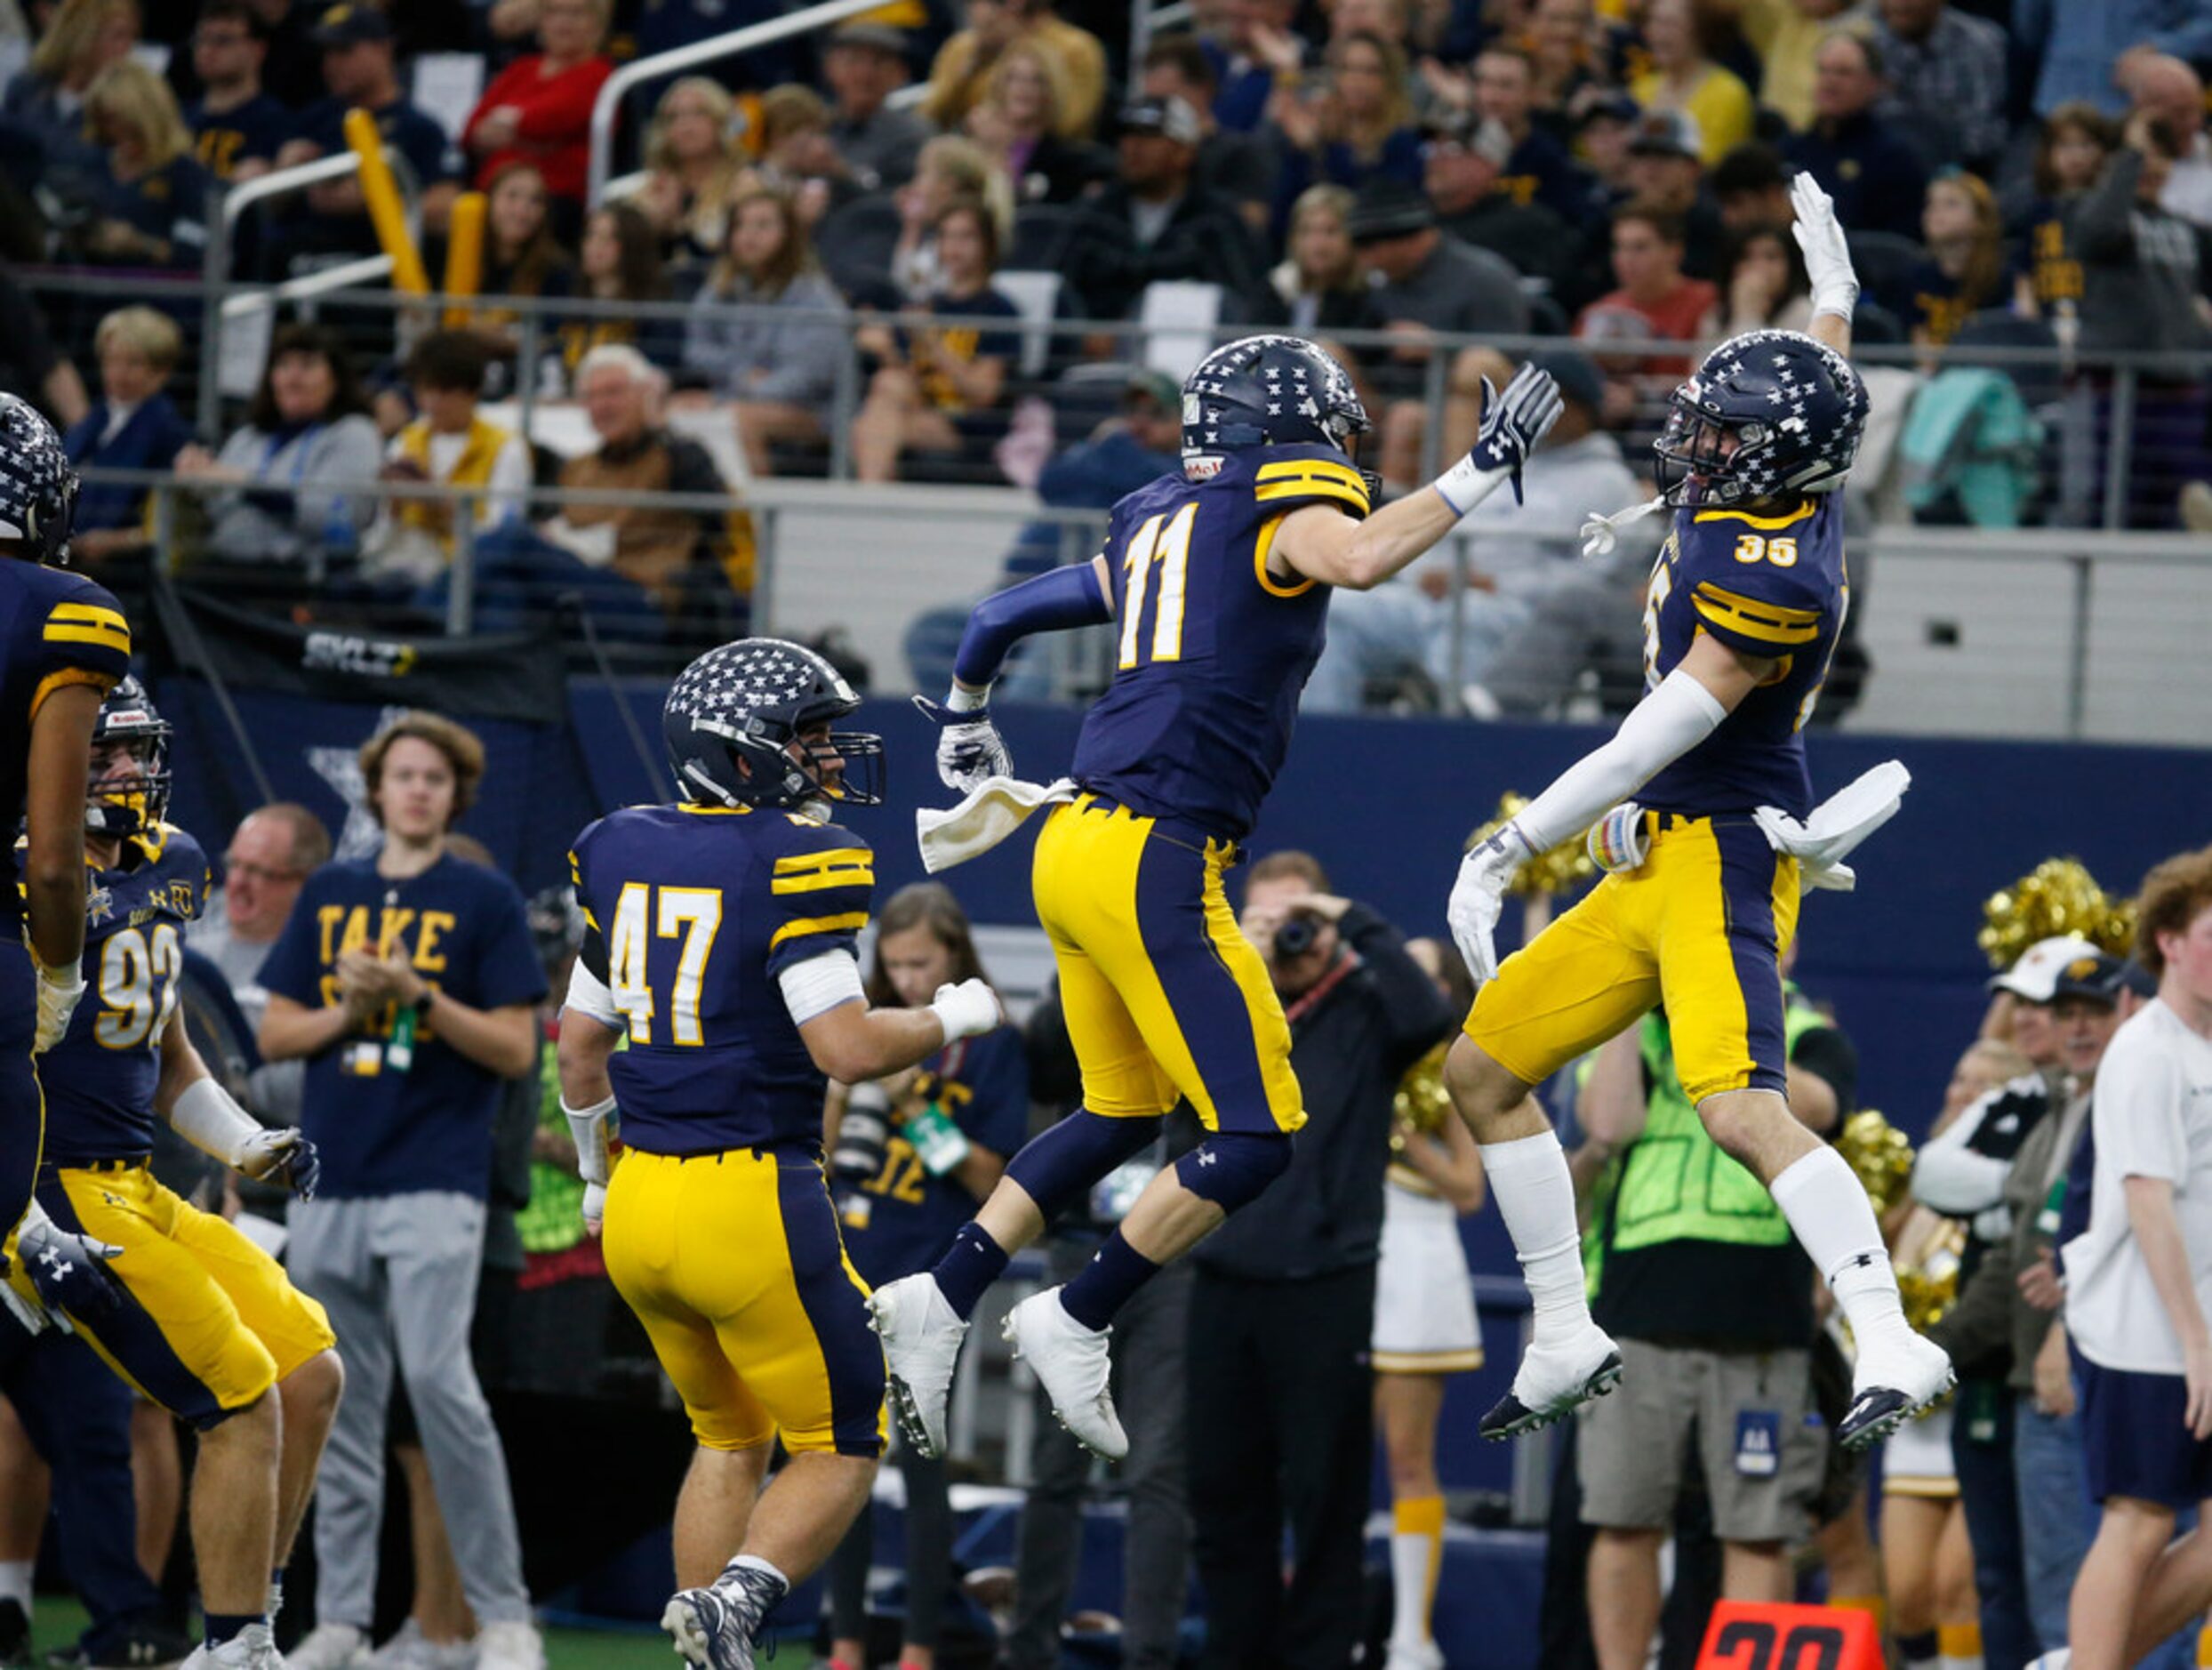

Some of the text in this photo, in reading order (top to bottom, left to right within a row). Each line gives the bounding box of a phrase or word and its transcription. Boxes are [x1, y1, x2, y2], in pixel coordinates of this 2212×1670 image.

[1118, 502, 1199, 670] 11
[1735, 534, 1798, 567] 35
[94, 923, 182, 1050] 92
[317, 904, 456, 972] TAKE
[609, 881, 723, 1046] 47
